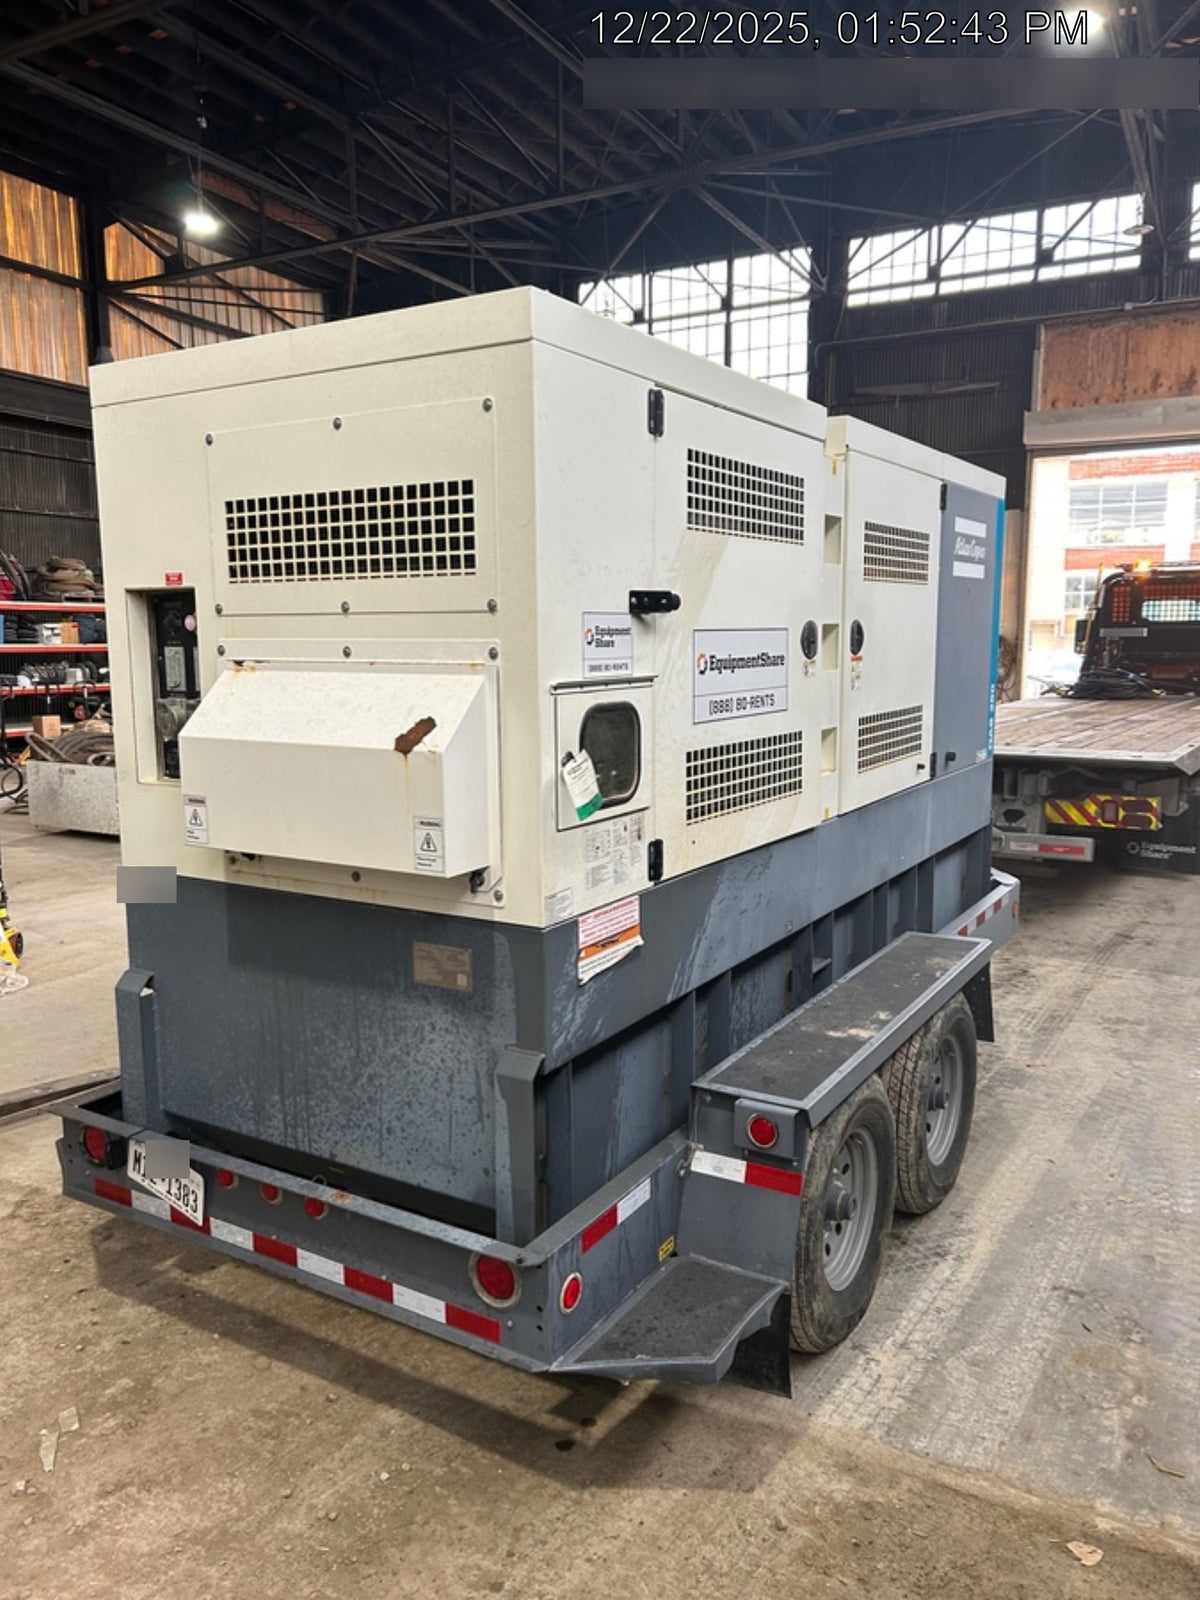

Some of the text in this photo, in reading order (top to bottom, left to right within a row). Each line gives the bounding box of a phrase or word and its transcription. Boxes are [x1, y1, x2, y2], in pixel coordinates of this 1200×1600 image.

[595, 625, 632, 638] Equipment
[594, 638, 615, 648] Share
[709, 652, 785, 674] EquipmentShare
[709, 693, 776, 716] (888) 80-RENTS
